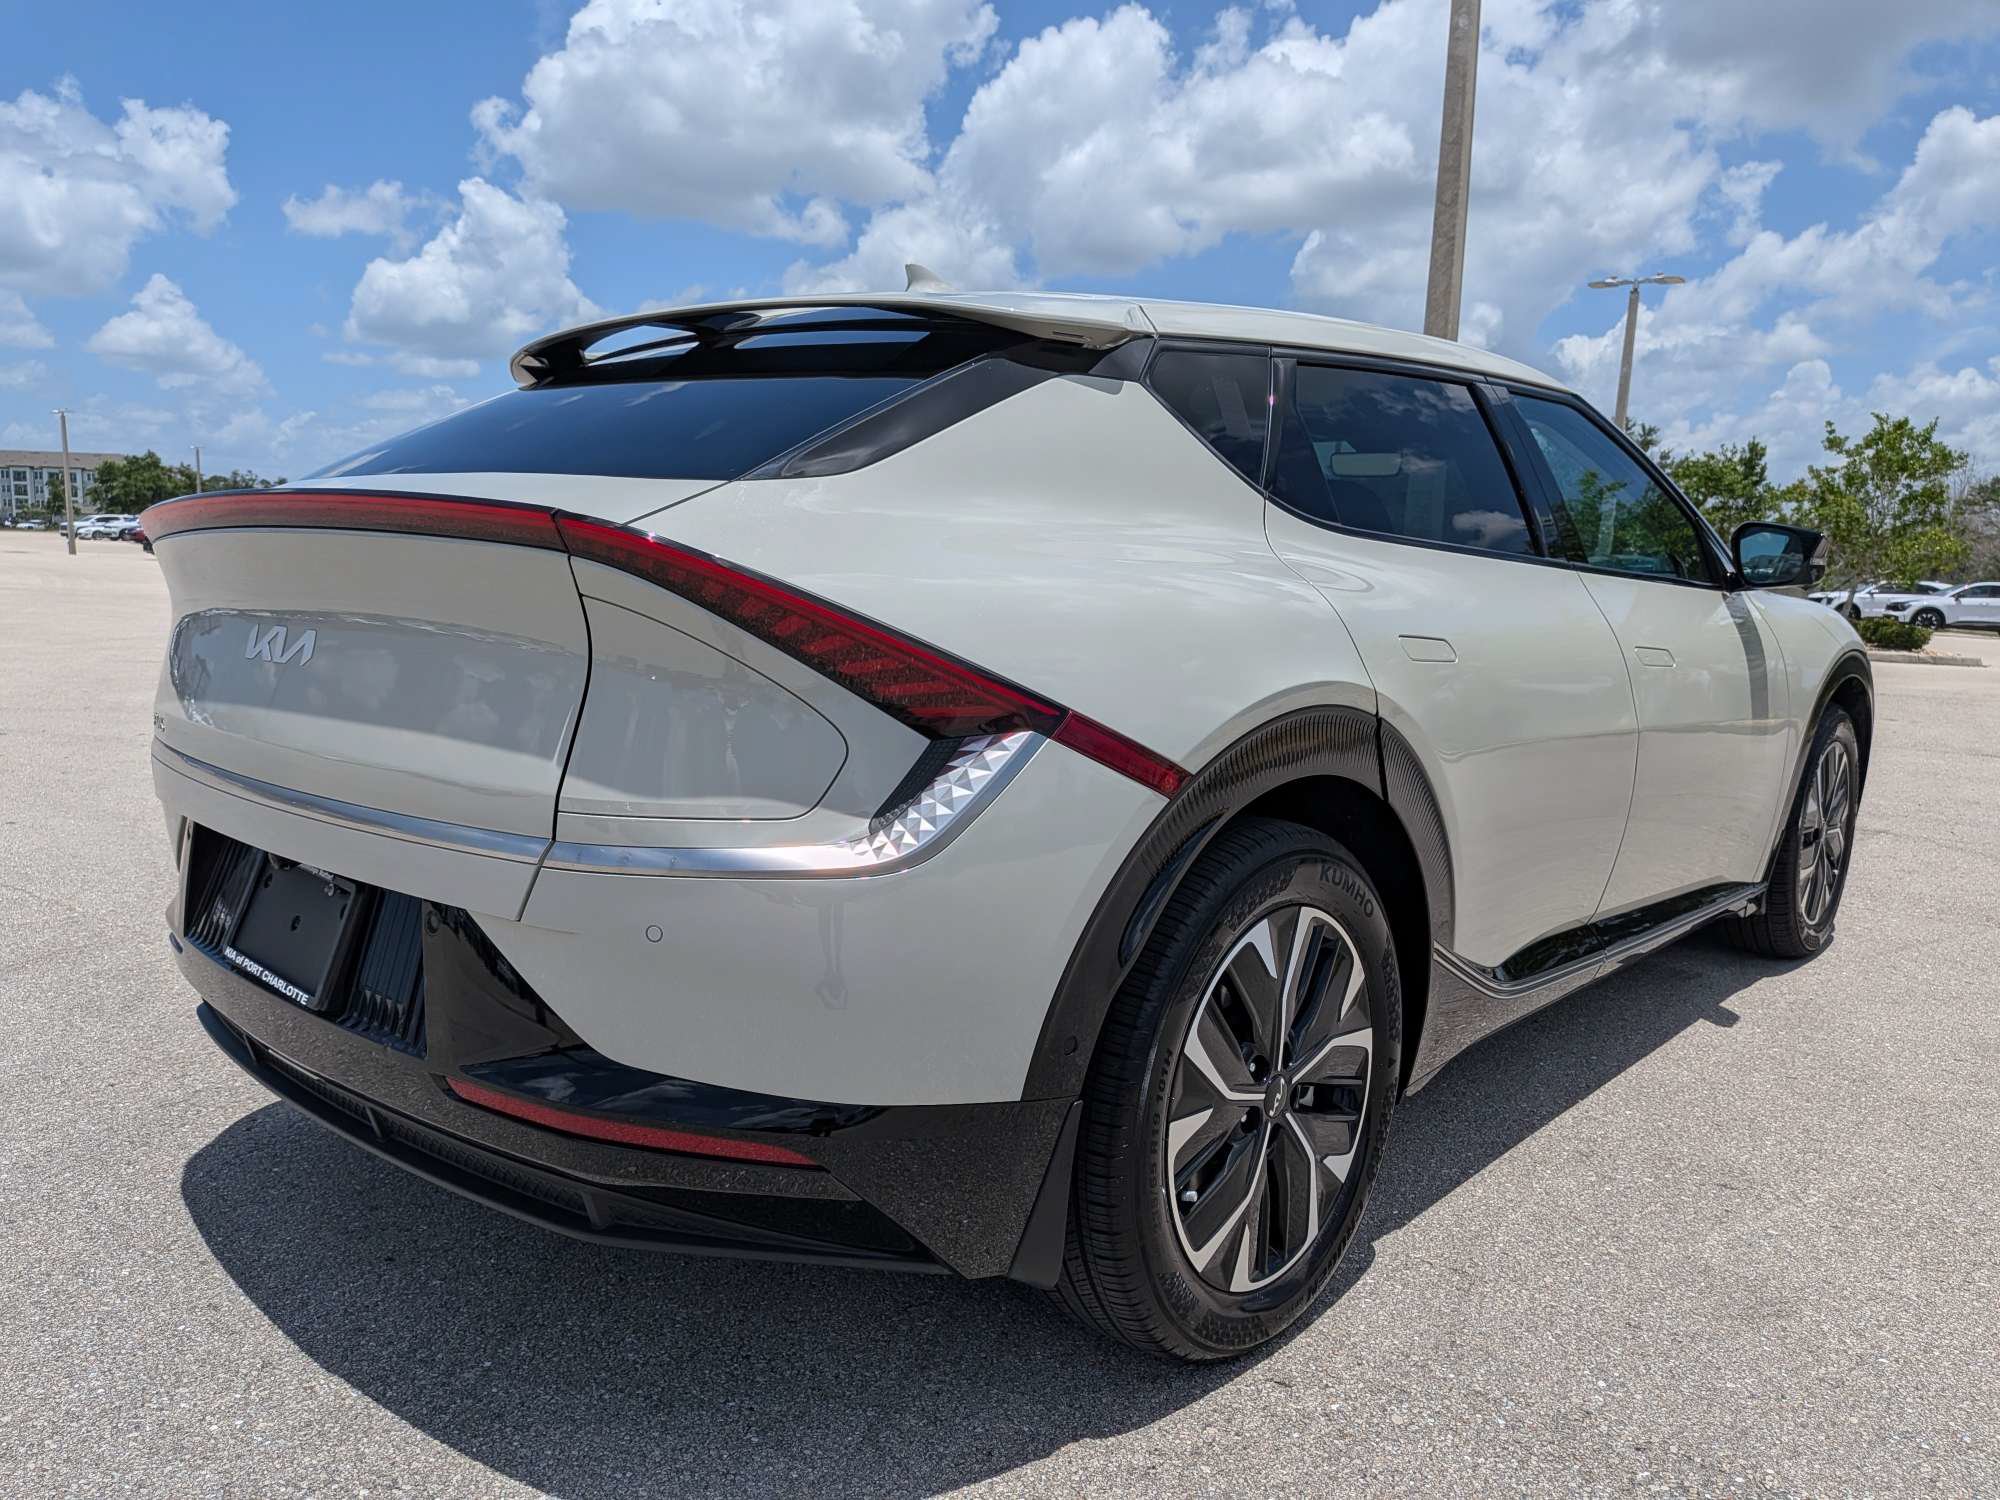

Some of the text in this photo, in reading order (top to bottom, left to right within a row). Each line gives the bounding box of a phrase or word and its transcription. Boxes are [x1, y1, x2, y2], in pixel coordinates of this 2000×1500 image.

[245, 624, 318, 666] KIA
[1319, 864, 1375, 918] KUMHO
[224, 946, 309, 1006] KIA of PORT CHARLOTTE
